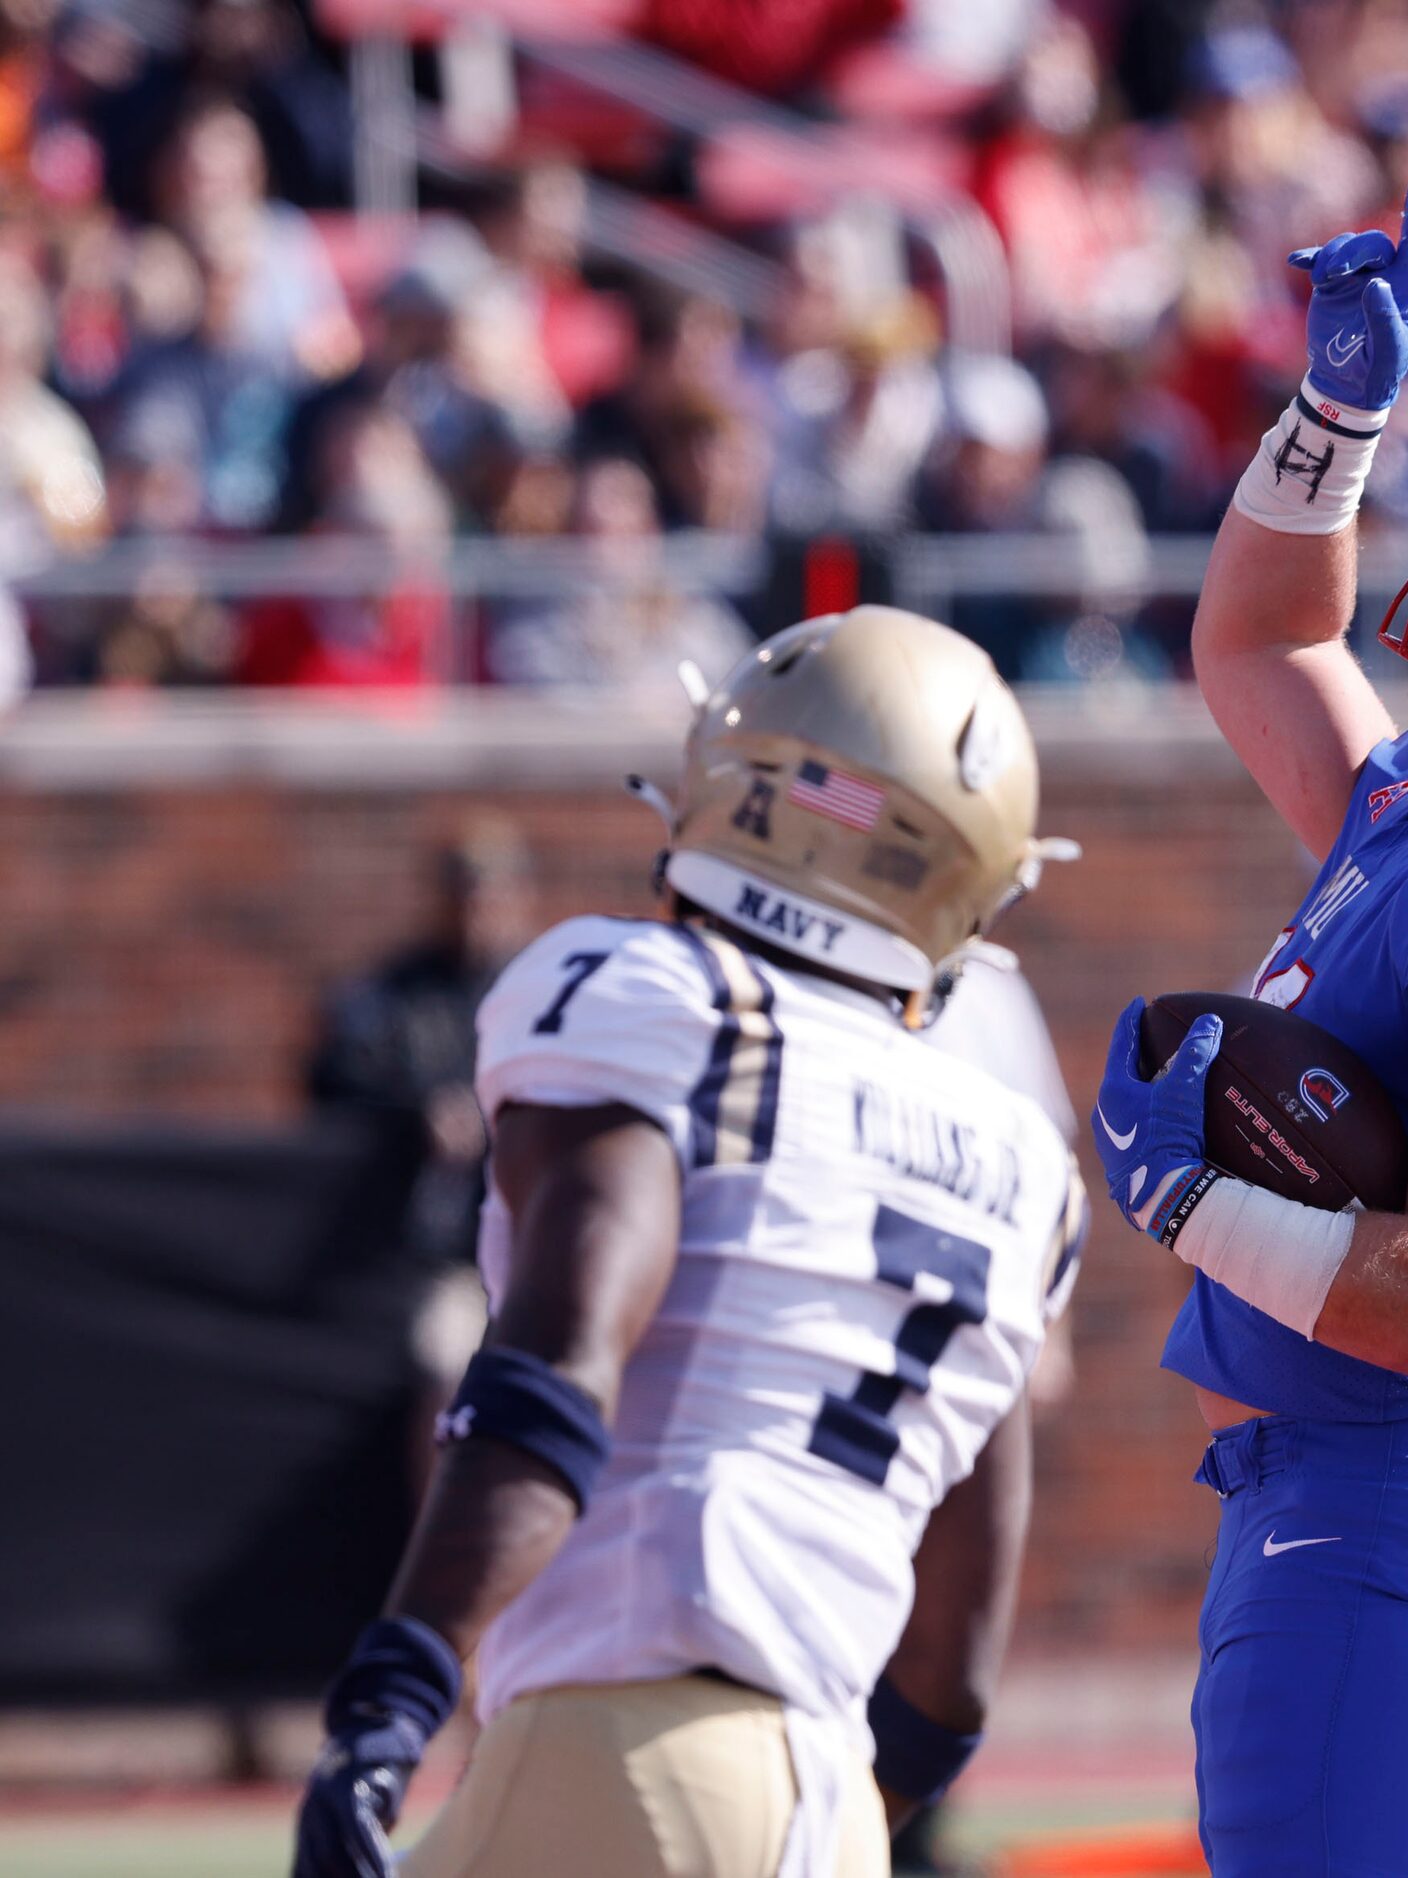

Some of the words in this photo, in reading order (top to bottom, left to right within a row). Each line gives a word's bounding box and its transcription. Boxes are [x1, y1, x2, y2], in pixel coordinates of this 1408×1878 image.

[1317, 402, 1340, 421] RSF
[736, 882, 845, 951] NAVY
[532, 951, 610, 1036] 7
[1224, 1086, 1272, 1133] ELITE
[1268, 1128, 1320, 1184] VAPOR
[1179, 1194, 1197, 1216] CAN
[1194, 1177, 1209, 1193] WE
[806, 1203, 992, 1487] 7
